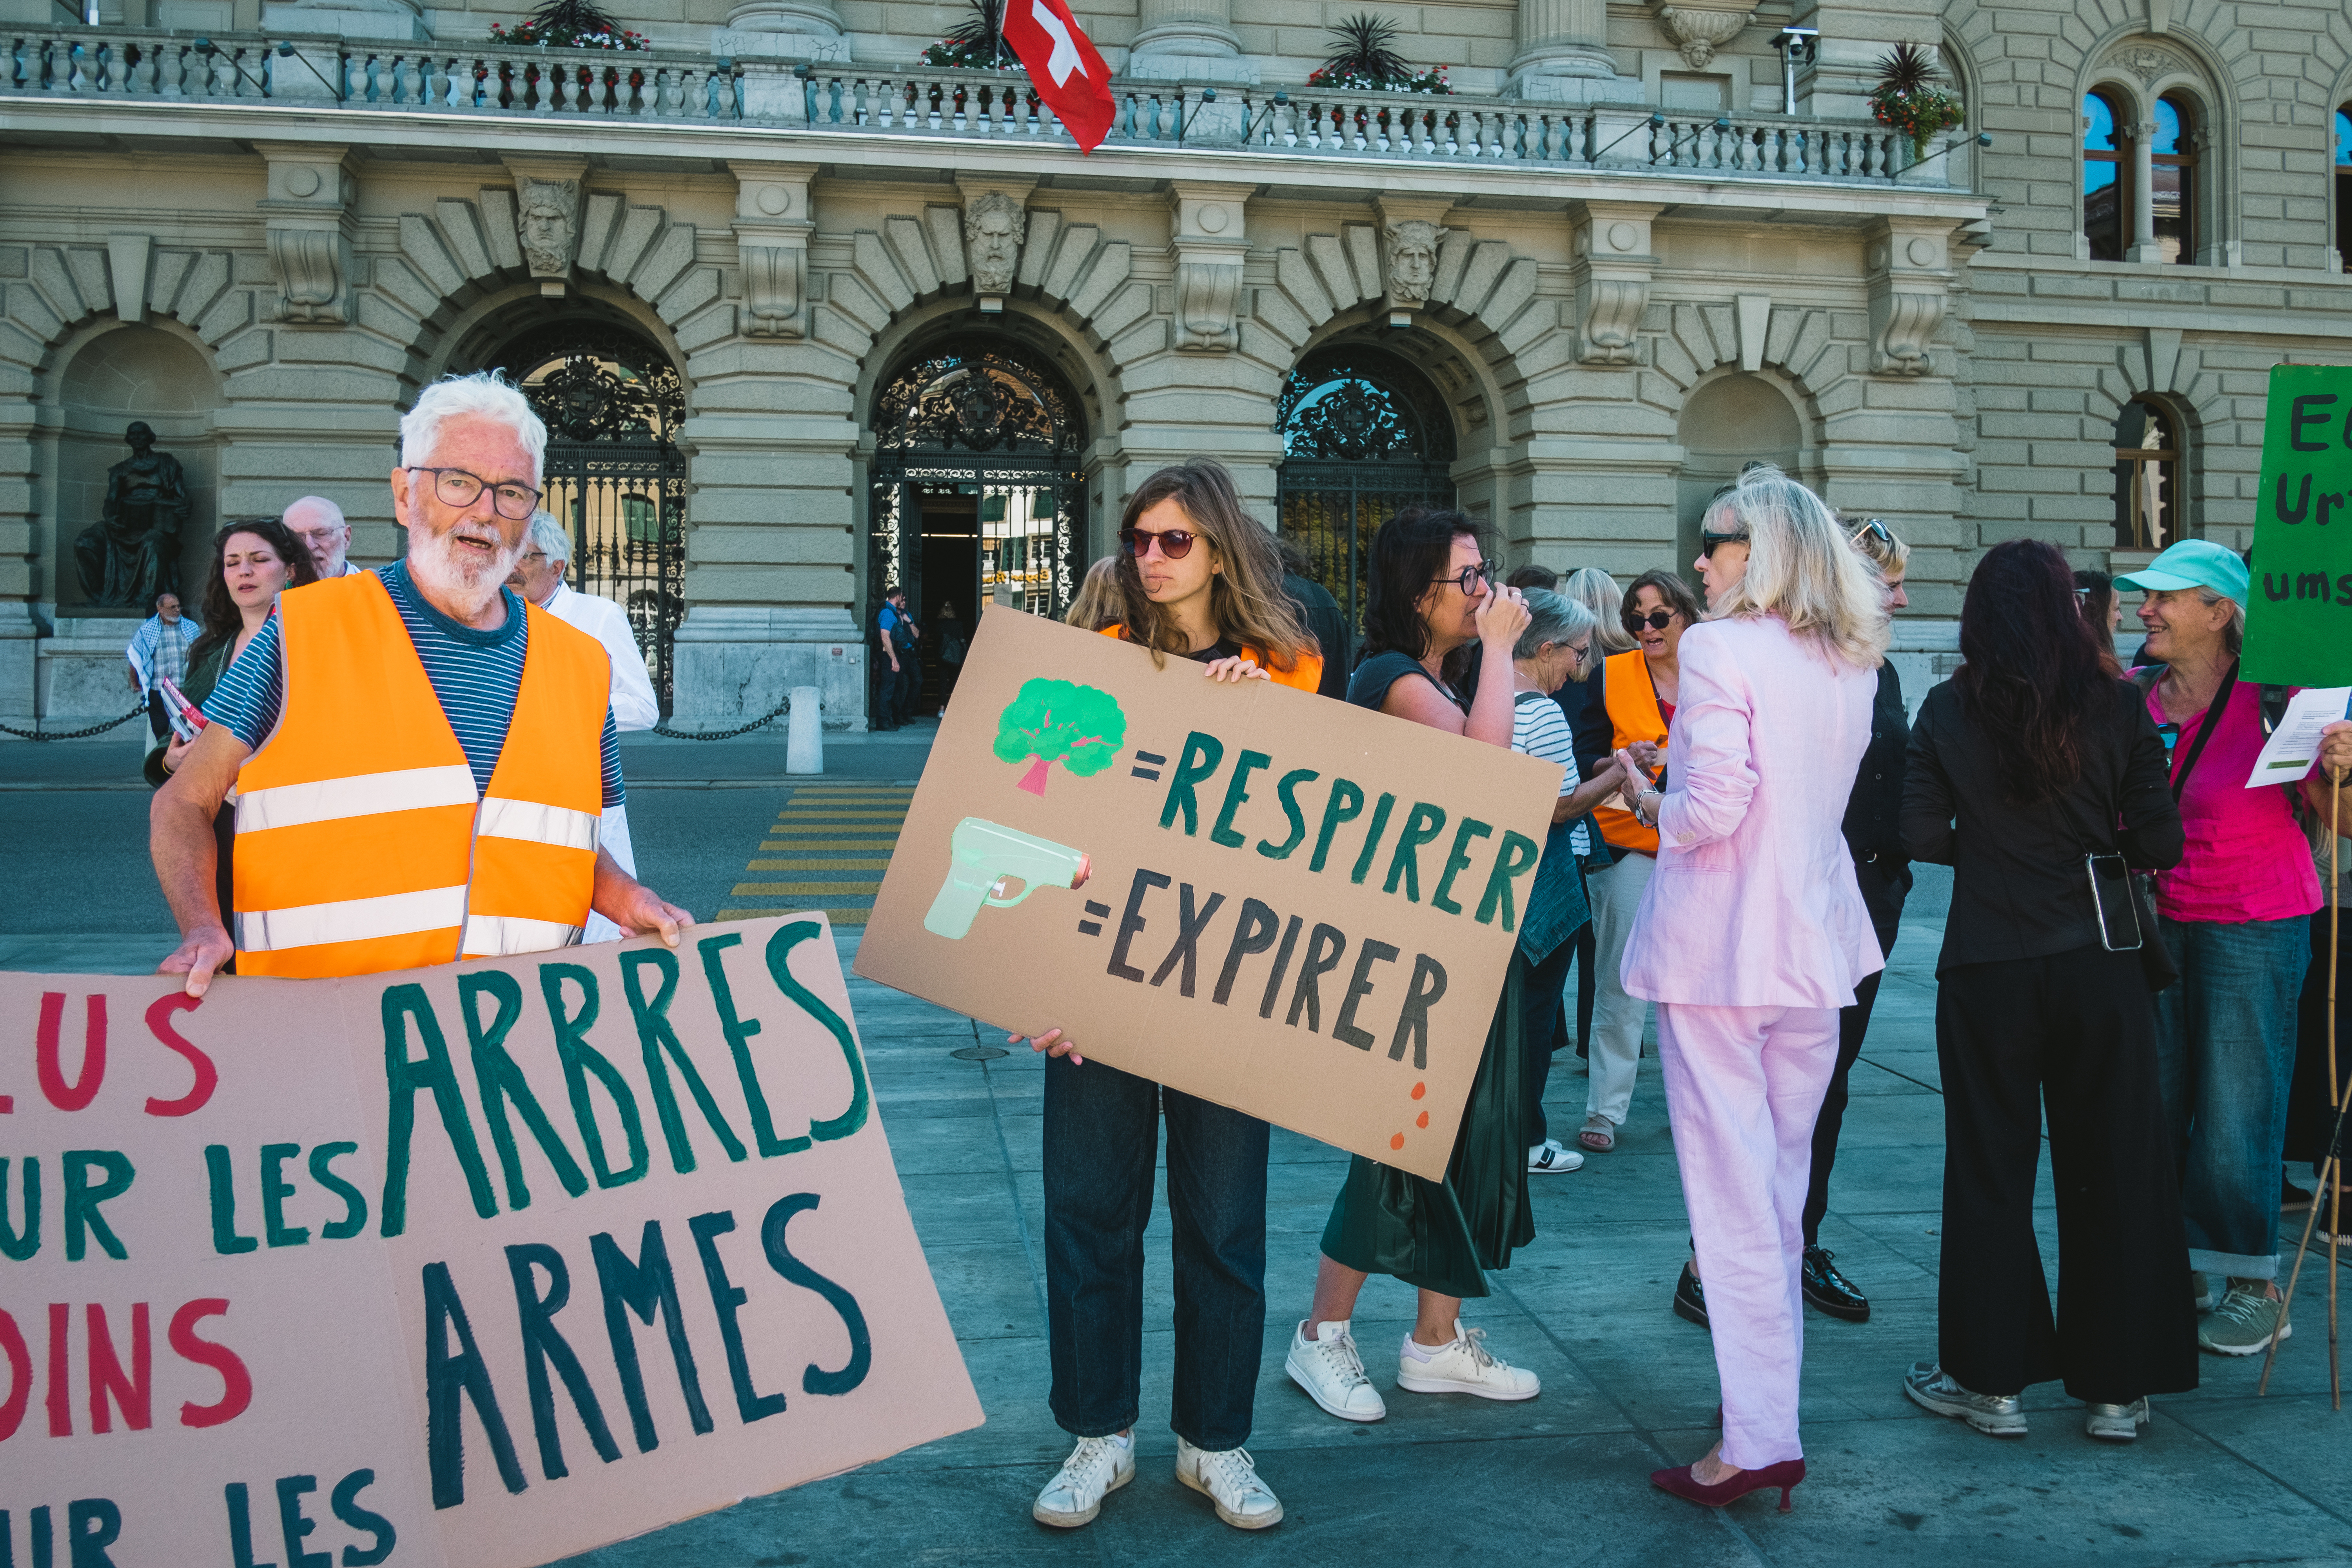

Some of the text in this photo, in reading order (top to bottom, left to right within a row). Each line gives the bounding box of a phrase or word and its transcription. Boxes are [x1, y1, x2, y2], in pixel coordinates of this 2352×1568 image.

[2291, 394, 2352, 452] E
[2276, 472, 2352, 525] Ur
[0, 991, 218, 1117] US
[203, 1141, 368, 1255] LES
[379, 920, 870, 1239] ARBRES
[224, 1468, 396, 1568] LES
[422, 1192, 872, 1510] ARMES
